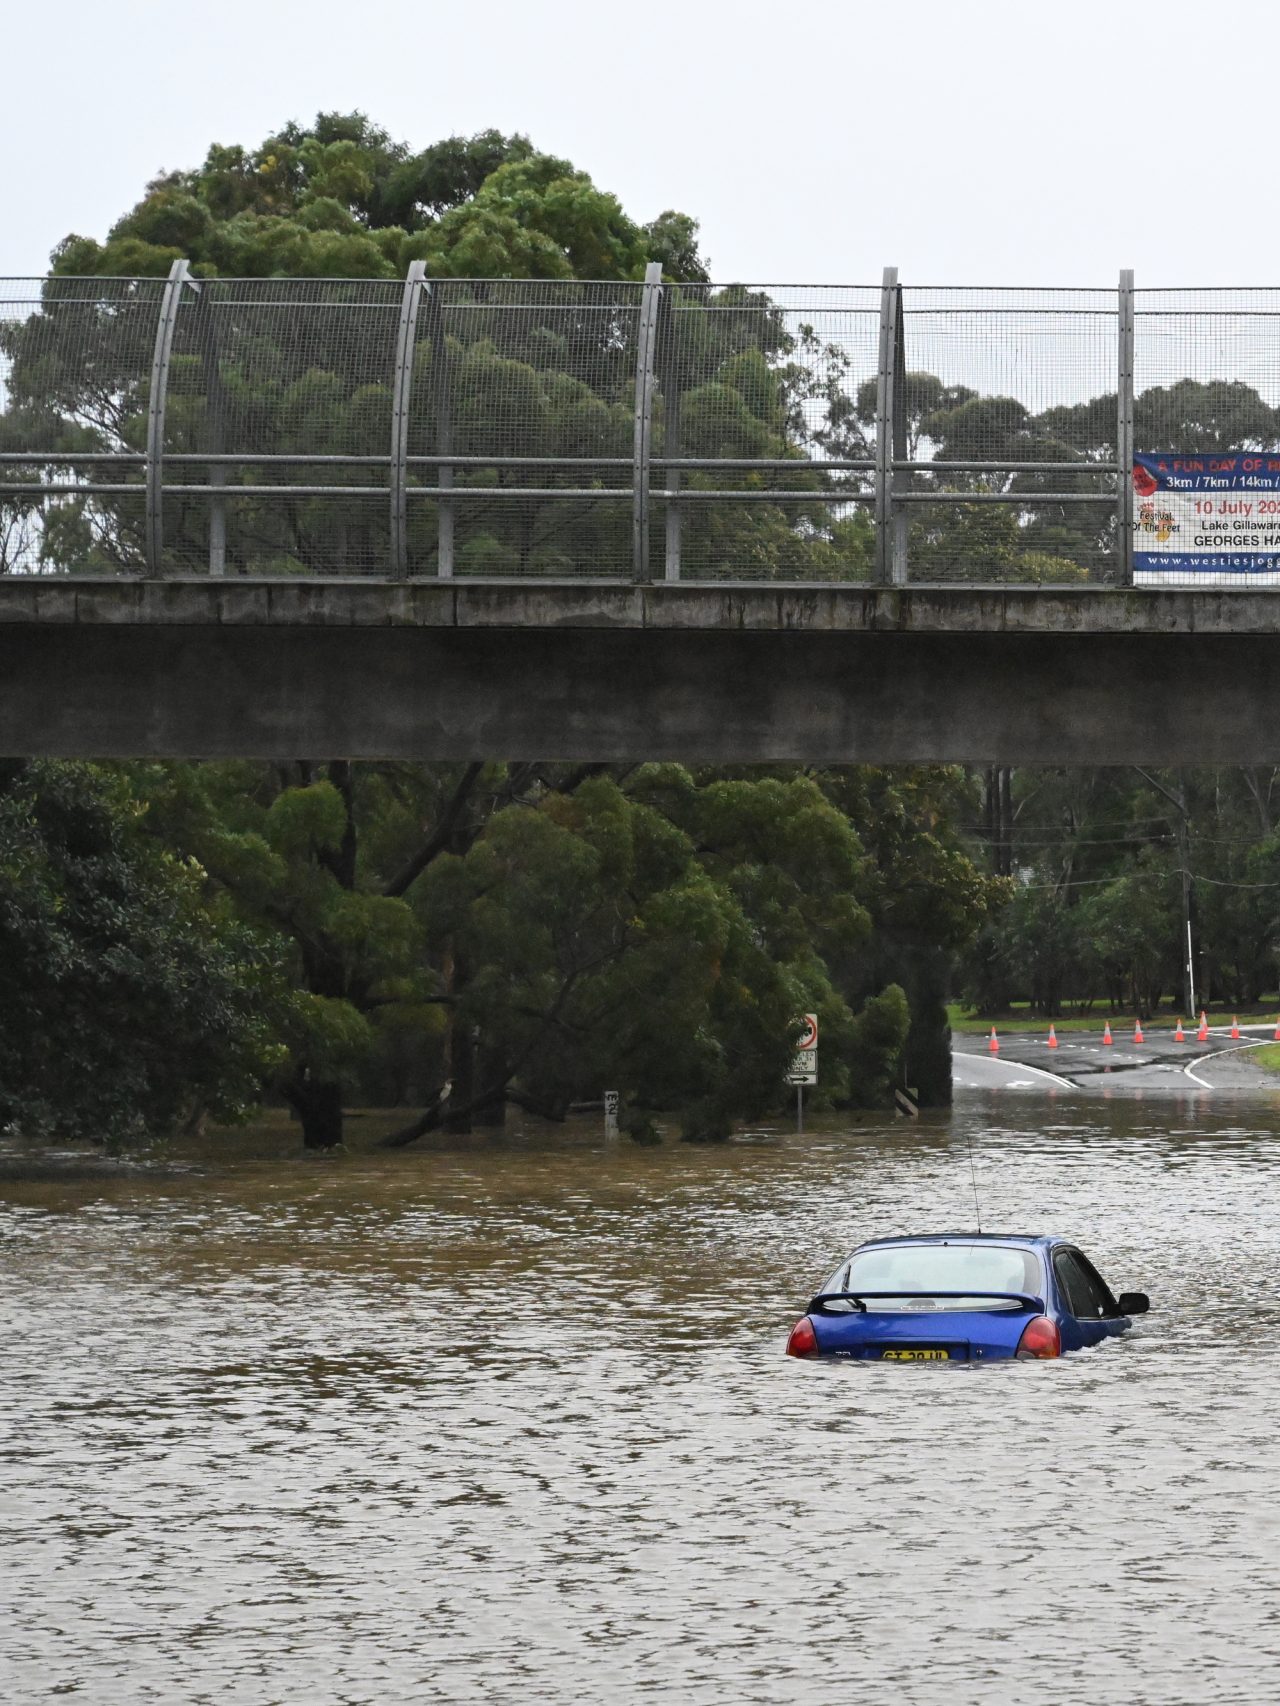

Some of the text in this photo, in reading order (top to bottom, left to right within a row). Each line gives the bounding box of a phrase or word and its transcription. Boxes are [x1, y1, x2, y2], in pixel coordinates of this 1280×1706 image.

[1158, 461, 1168, 472] A
[1173, 460, 1204, 472] FUN
[1209, 460, 1237, 472] DAY
[1242, 459, 1263, 472] OF
[1166, 476, 1193, 488] 3km
[1202, 476, 1229, 488] 7km
[1239, 475, 1272, 488] 14km
[1194, 500, 1213, 515] 10
[1218, 500, 1253, 517] July
[1144, 522, 1160, 532] The
[1162, 523, 1180, 533] Feet
[1201, 520, 1229, 531] Lake
[1194, 535, 1259, 546] GEORGES
[608, 1103, 617, 1115] 2
